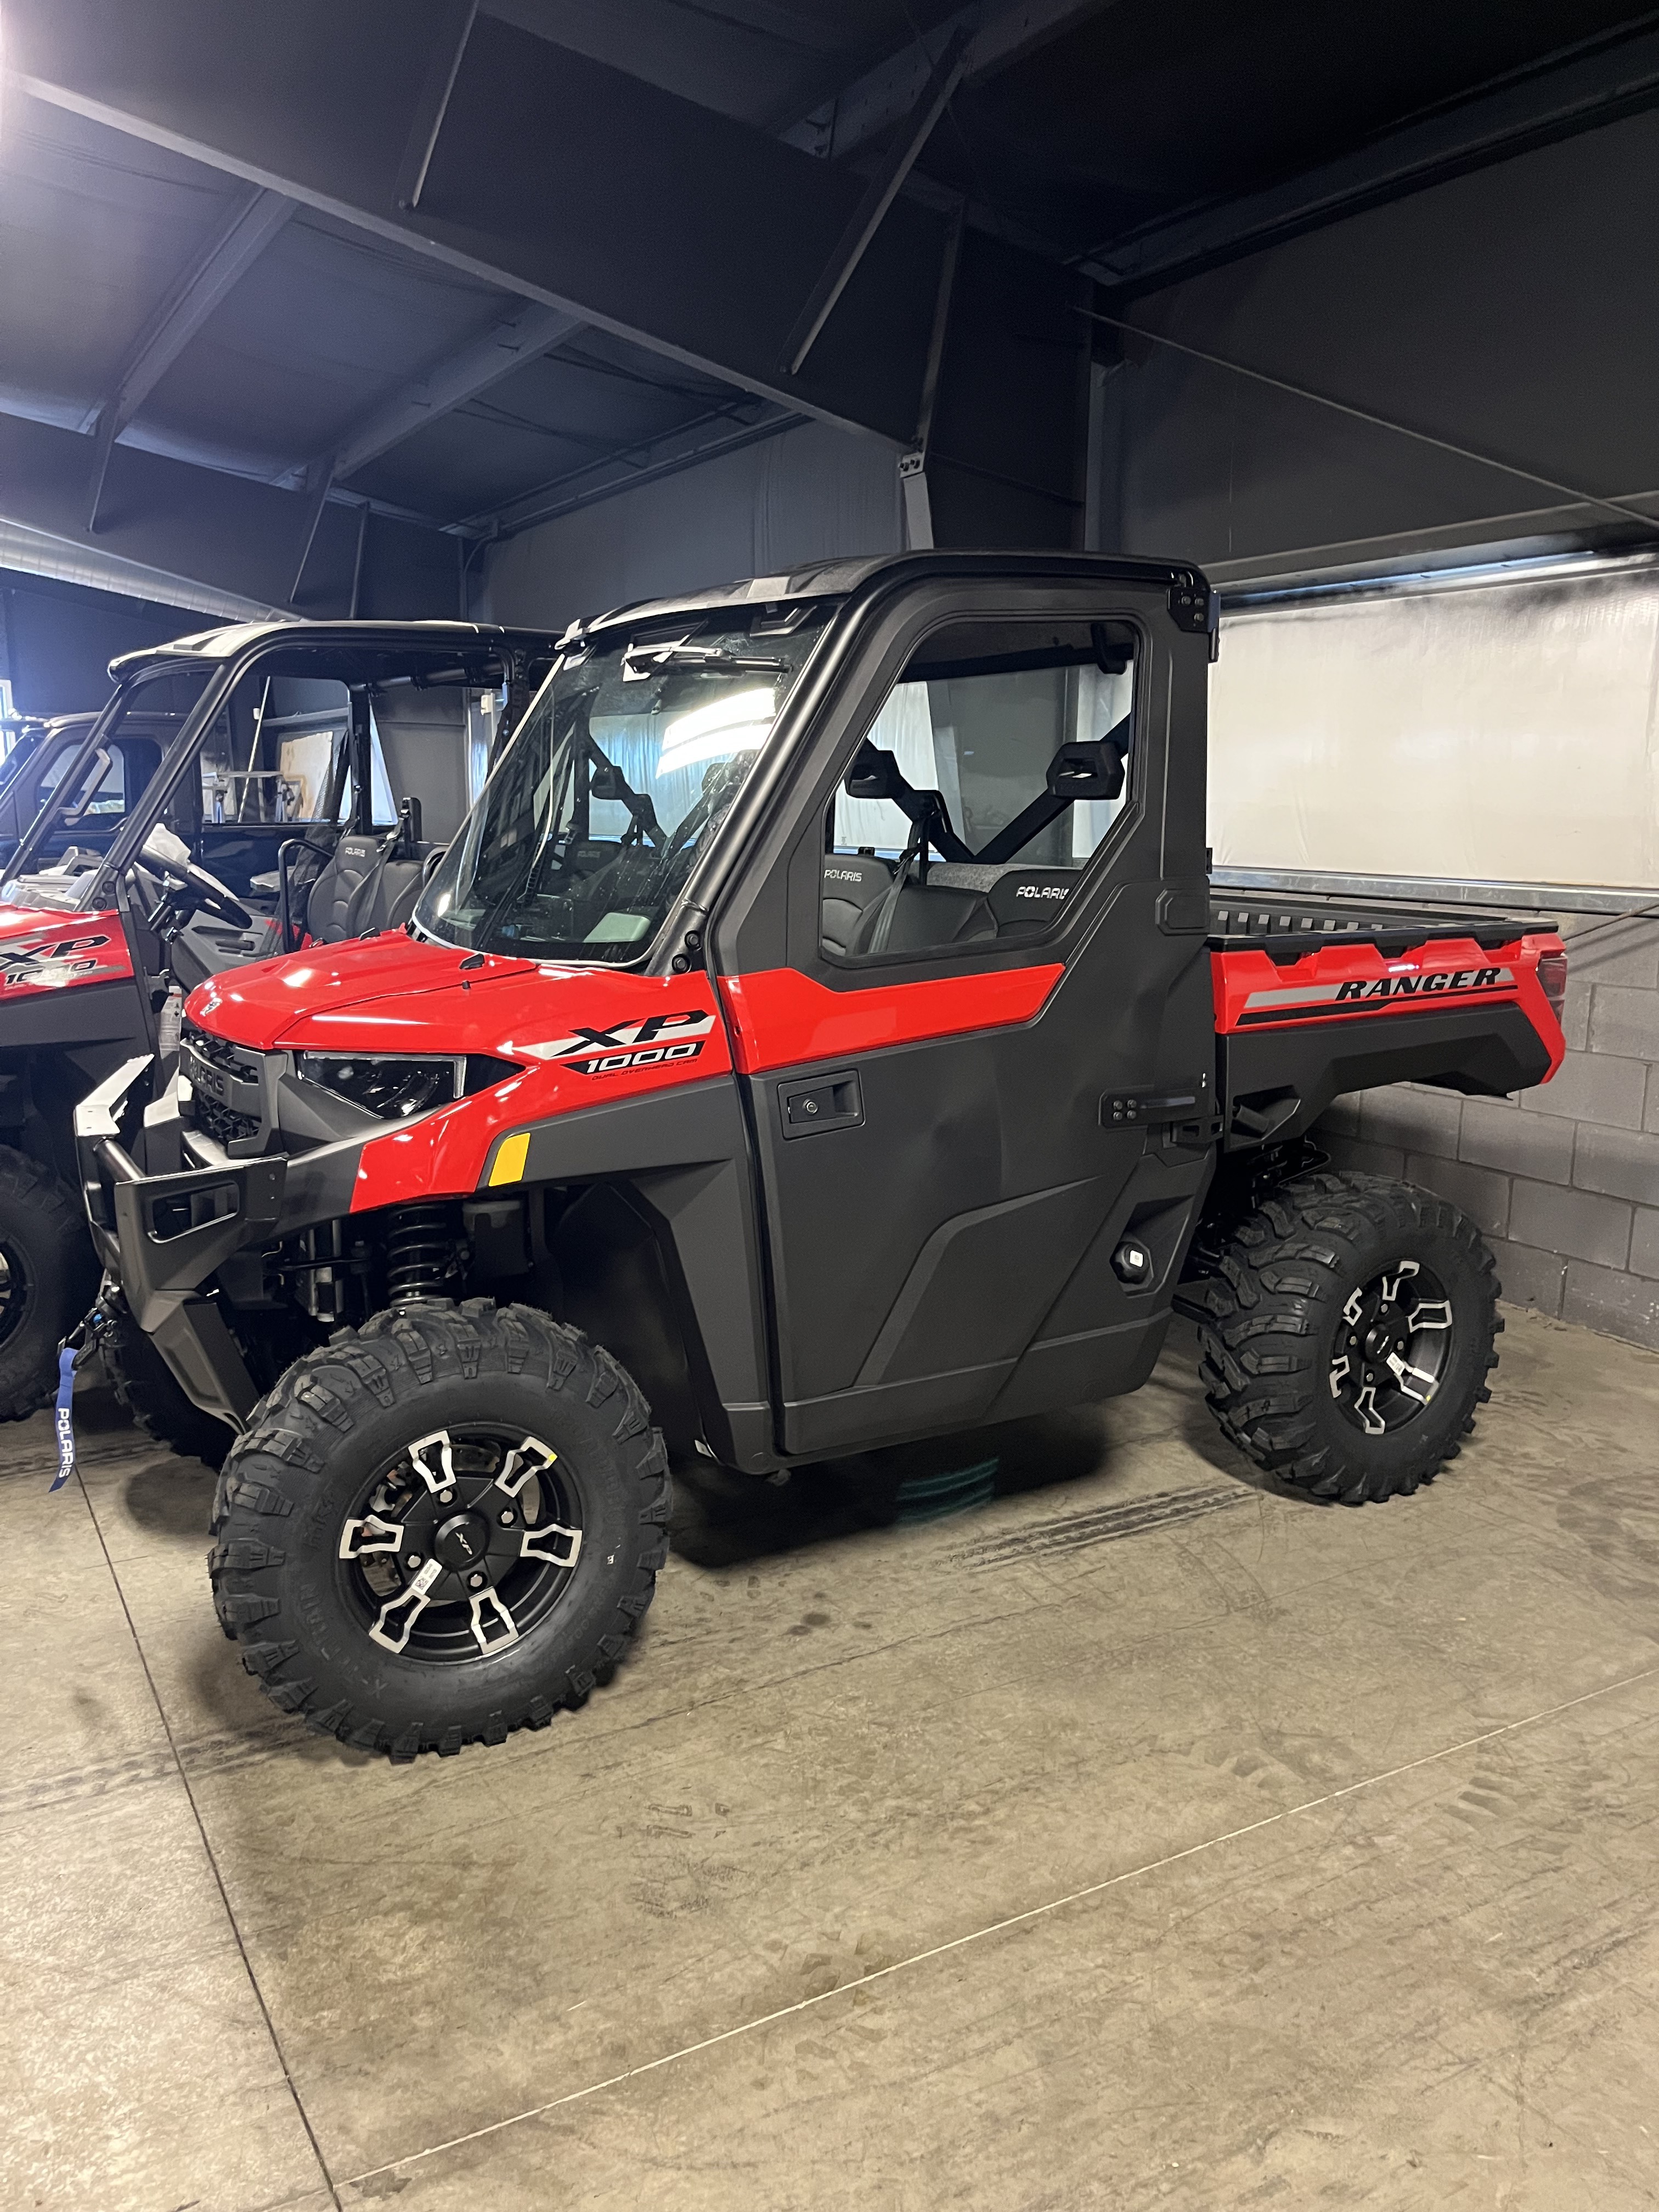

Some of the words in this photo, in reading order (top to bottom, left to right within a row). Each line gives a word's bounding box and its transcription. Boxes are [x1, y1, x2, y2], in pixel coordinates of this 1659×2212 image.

[824, 869, 862, 882] POLARIS
[0, 935, 110, 970] XP
[1335, 967, 1501, 1001] RANGER
[549, 1010, 709, 1058] XP
[587, 1043, 697, 1073] 1000
[591, 1073, 619, 1081] DUAL
[621, 1062, 674, 1075] OVERHEAD
[58, 1408, 74, 1478] POLARIS
[455, 1532, 473, 1555] XP
